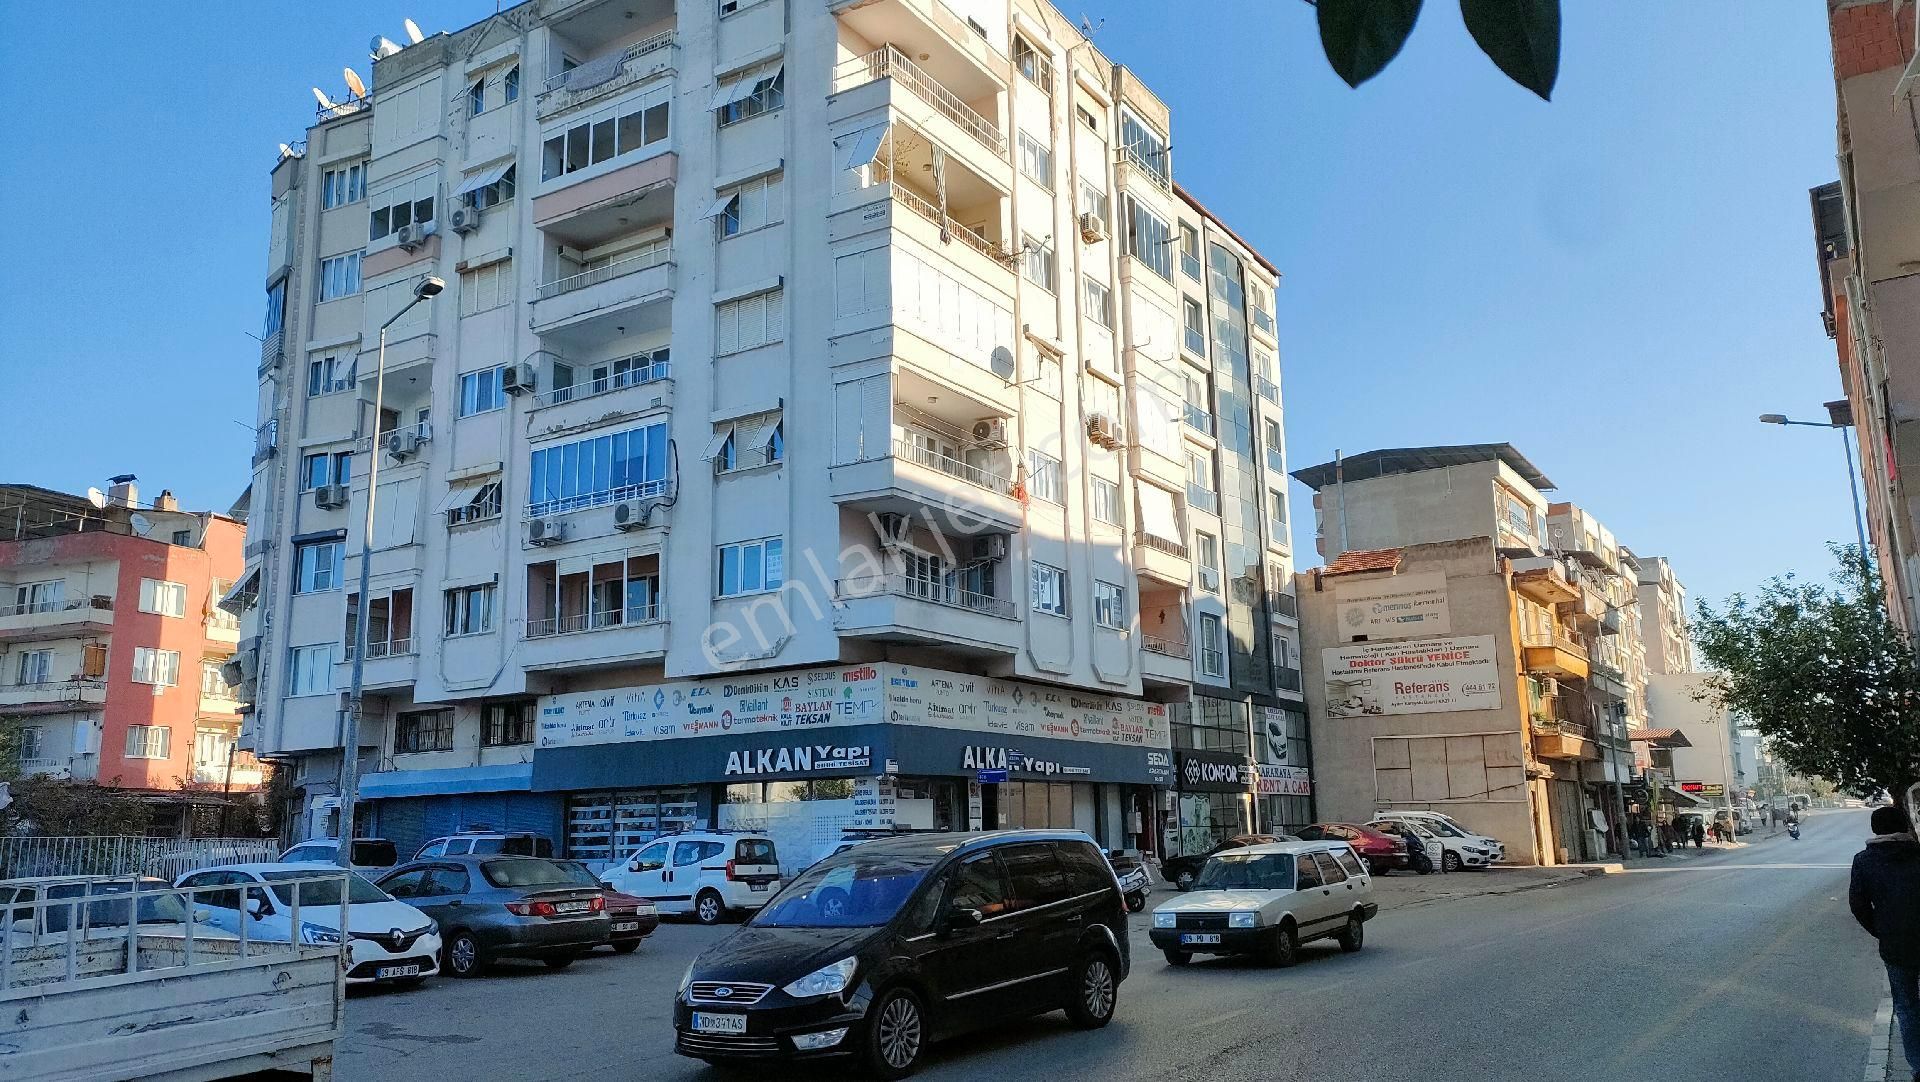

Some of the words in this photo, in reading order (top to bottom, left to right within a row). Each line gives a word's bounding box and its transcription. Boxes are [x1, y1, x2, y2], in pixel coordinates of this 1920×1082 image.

[1349, 658, 1386, 668] Doktor
[1394, 681, 1450, 695] Referans
[794, 700, 833, 713] BAYLAN
[795, 712, 831, 726] TEKSAN
[724, 746, 812, 776] ALKAN
[1023, 757, 1060, 776] Yapı
[1147, 752, 1170, 767] SEDA
[1201, 762, 1239, 783] KONFOR
[1283, 780, 1290, 793] A
[1292, 781, 1310, 795] CAR
